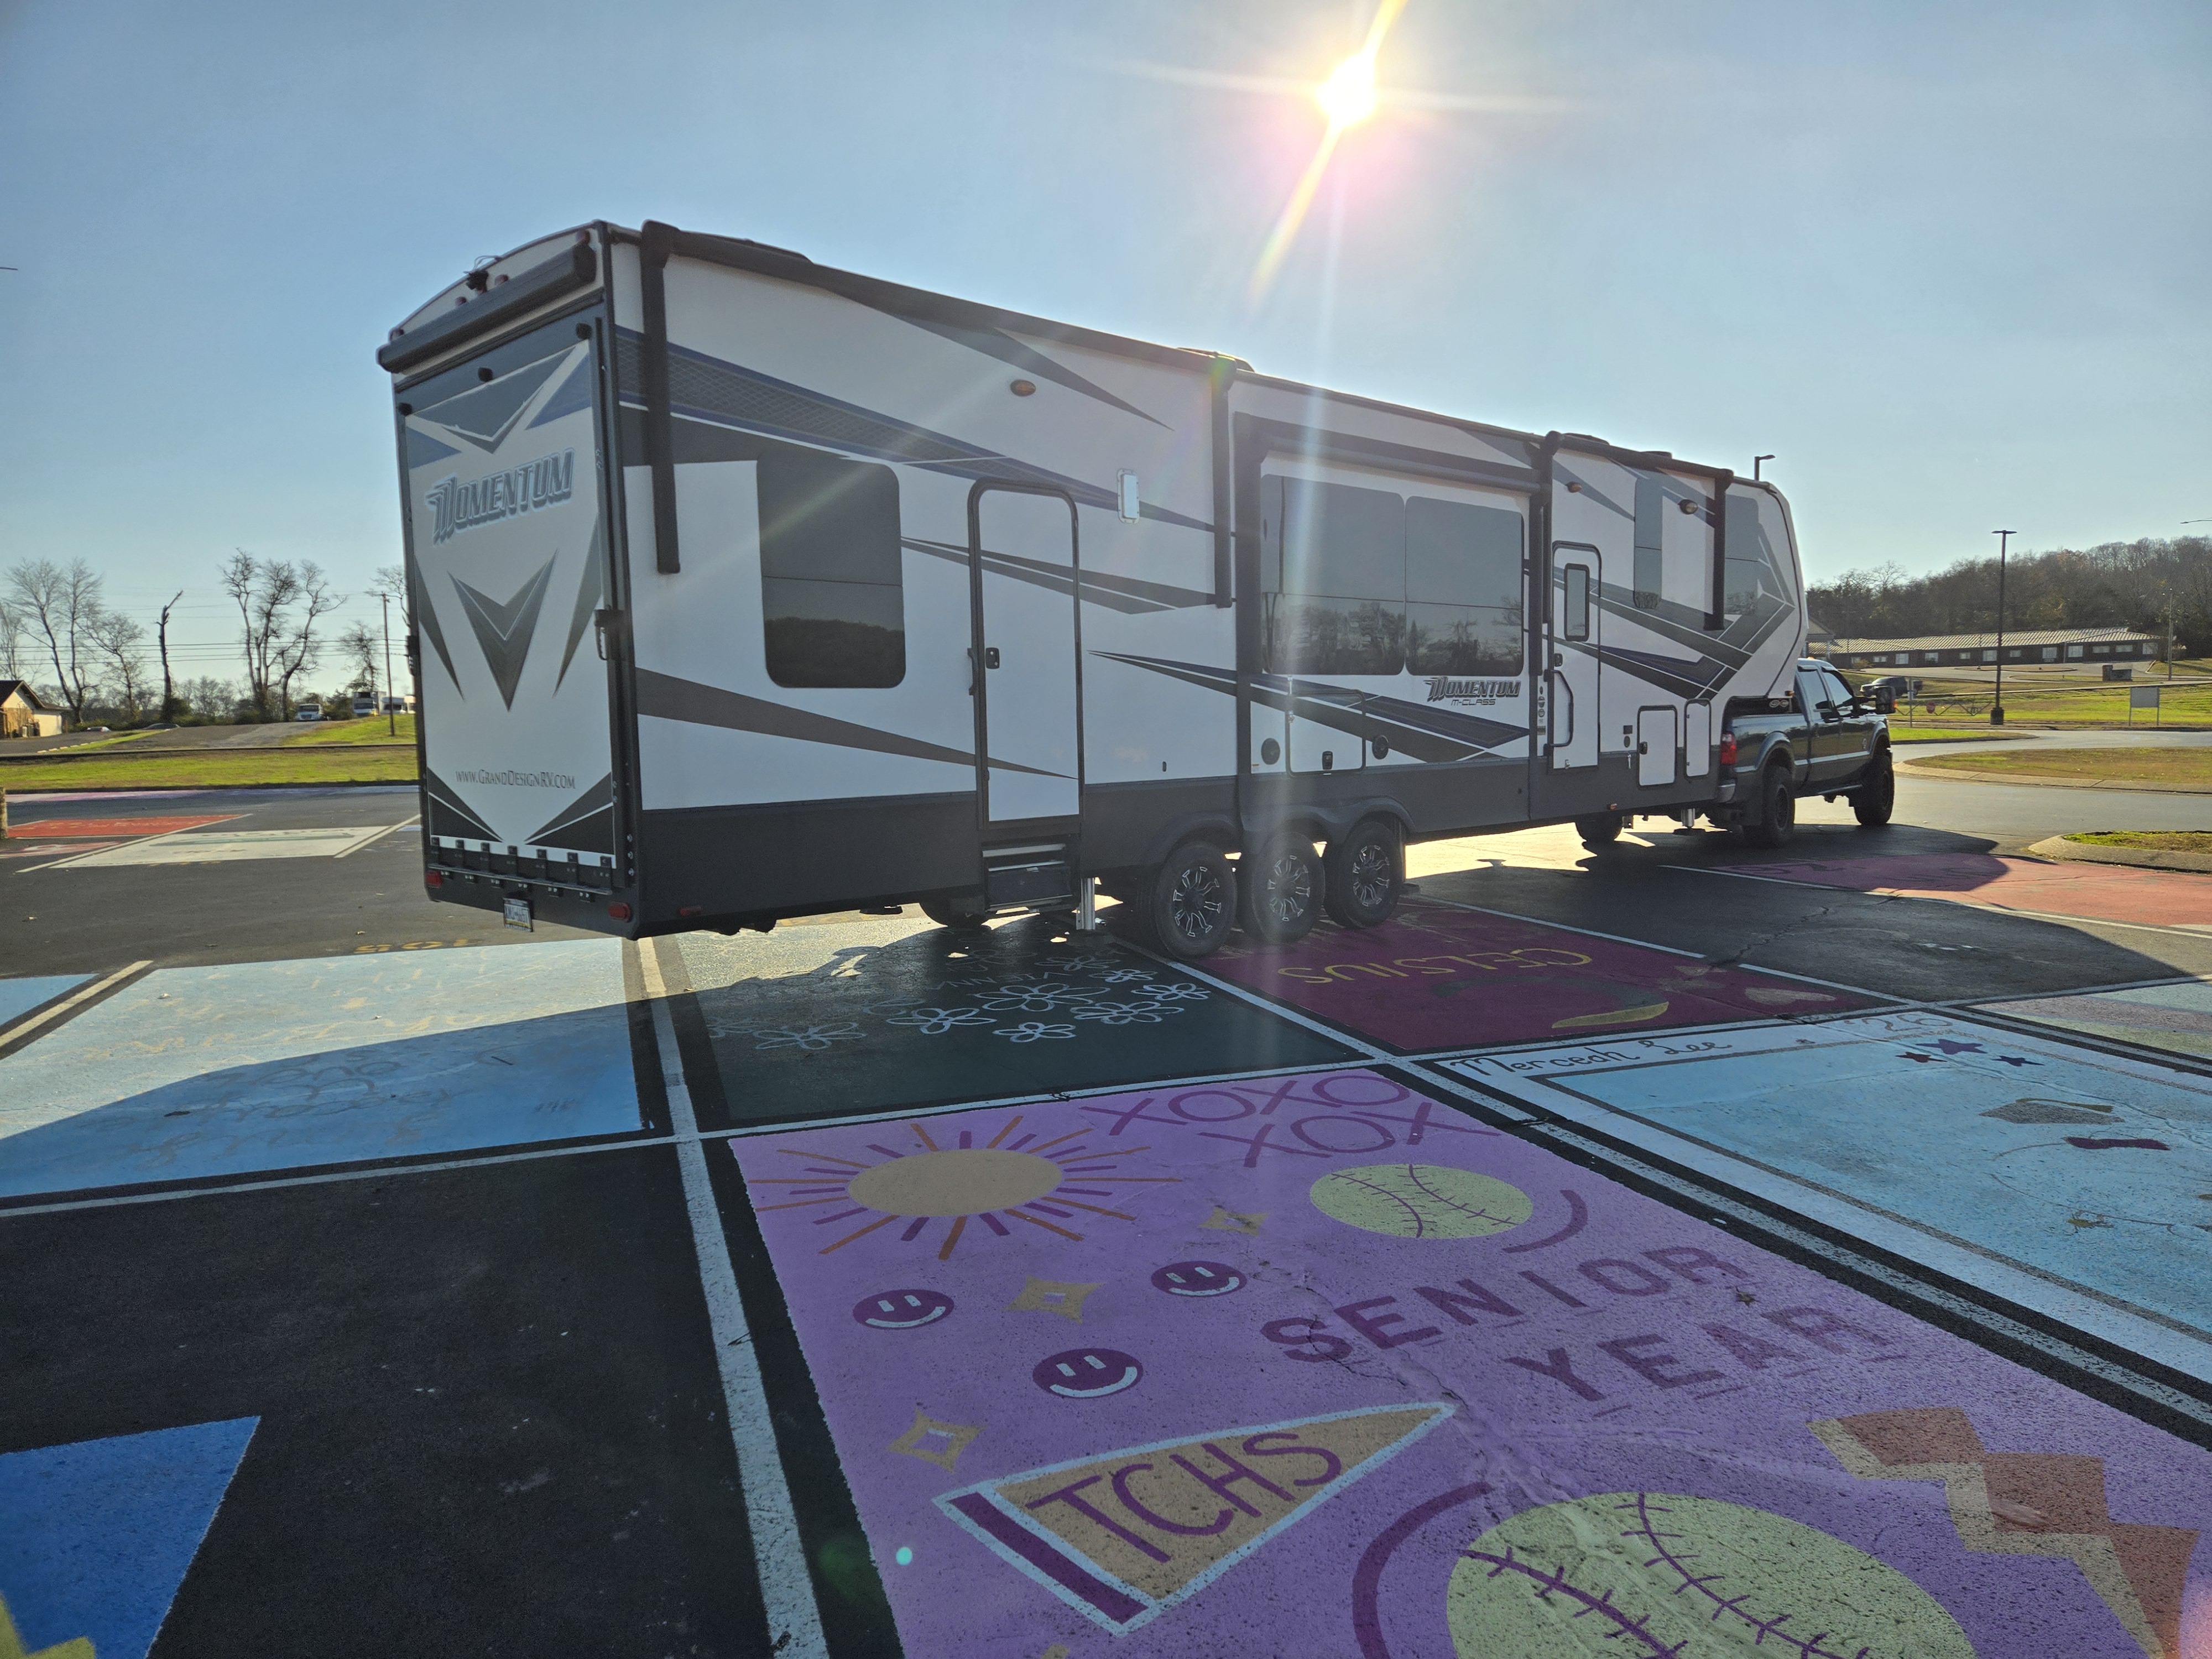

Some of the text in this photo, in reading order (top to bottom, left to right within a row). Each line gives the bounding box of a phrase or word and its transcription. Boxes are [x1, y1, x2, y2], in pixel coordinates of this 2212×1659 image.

[1423, 676, 1522, 702] MOMENTUM
[1279, 948, 1593, 984] CELSIUS
[1638, 1040, 1733, 1055] Lee
[1080, 1075, 1410, 1136] XOXO
[1198, 1102, 1502, 1168] XOX
[1260, 1246, 1754, 1364] SENIOR
[1503, 1307, 1890, 1402] YEAR
[1024, 1432, 1342, 1564] TCHS
